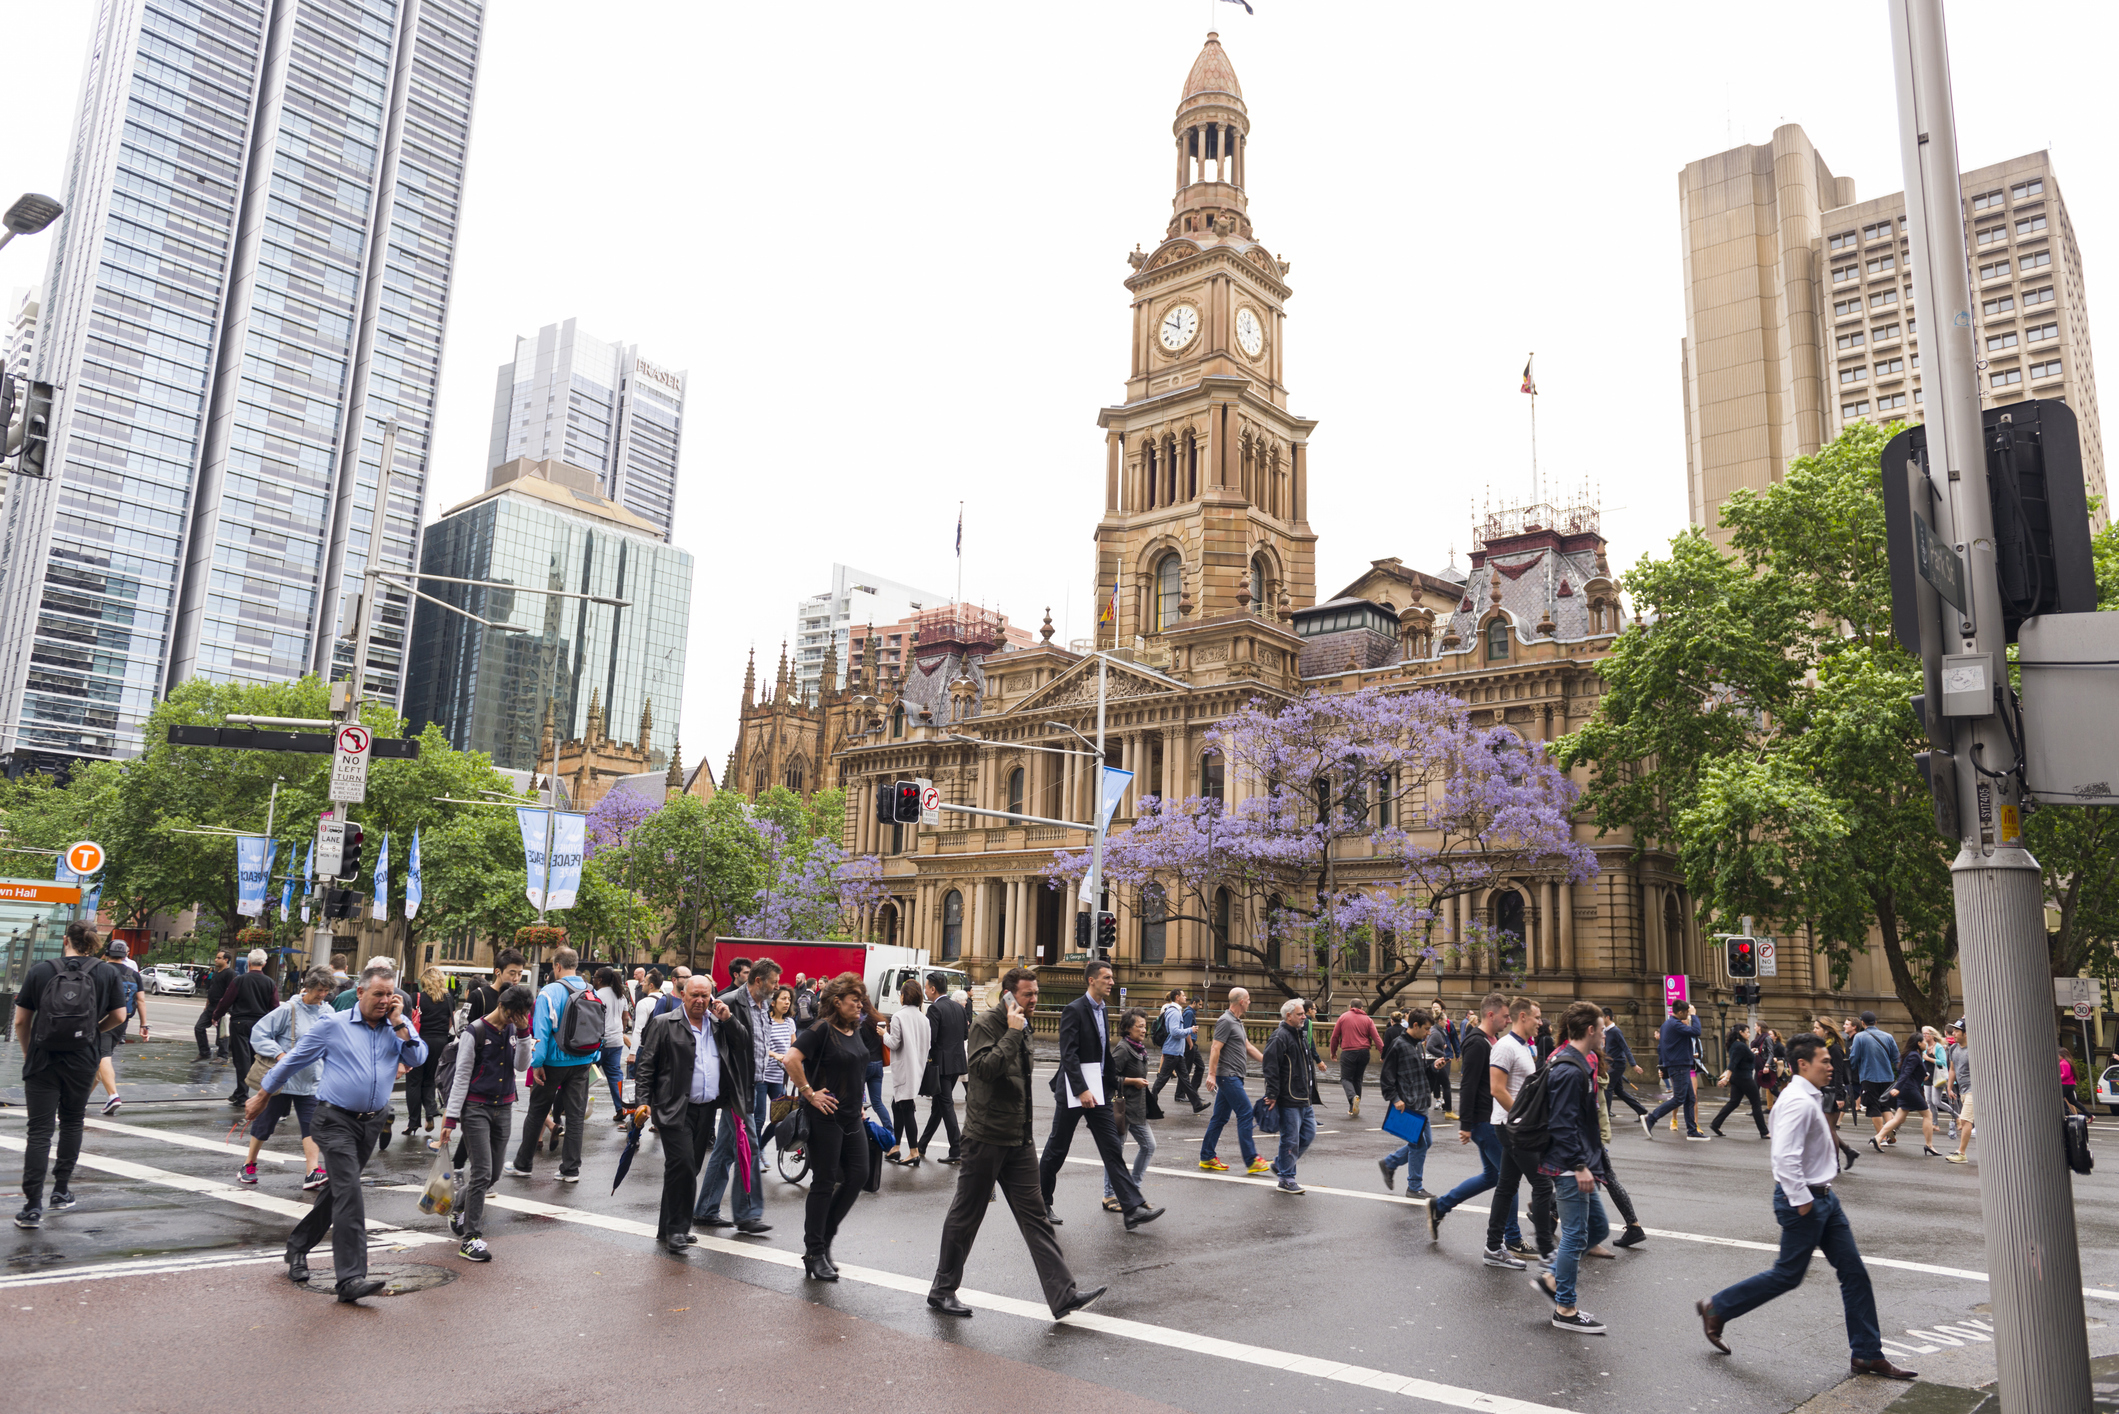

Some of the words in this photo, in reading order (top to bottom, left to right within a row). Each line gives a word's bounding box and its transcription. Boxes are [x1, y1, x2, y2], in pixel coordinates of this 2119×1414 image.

[636, 358, 681, 391] FRASER
[1945, 555, 1955, 586] St
[342, 755, 360, 765] NO
[338, 765, 361, 773] LEFT
[1979, 788, 1991, 818] SY17405
[321, 835, 341, 843] LANE
[78, 849, 95, 868] T
[15, 888, 37, 898] Hall
[2076, 1006, 2088, 1014] 30
